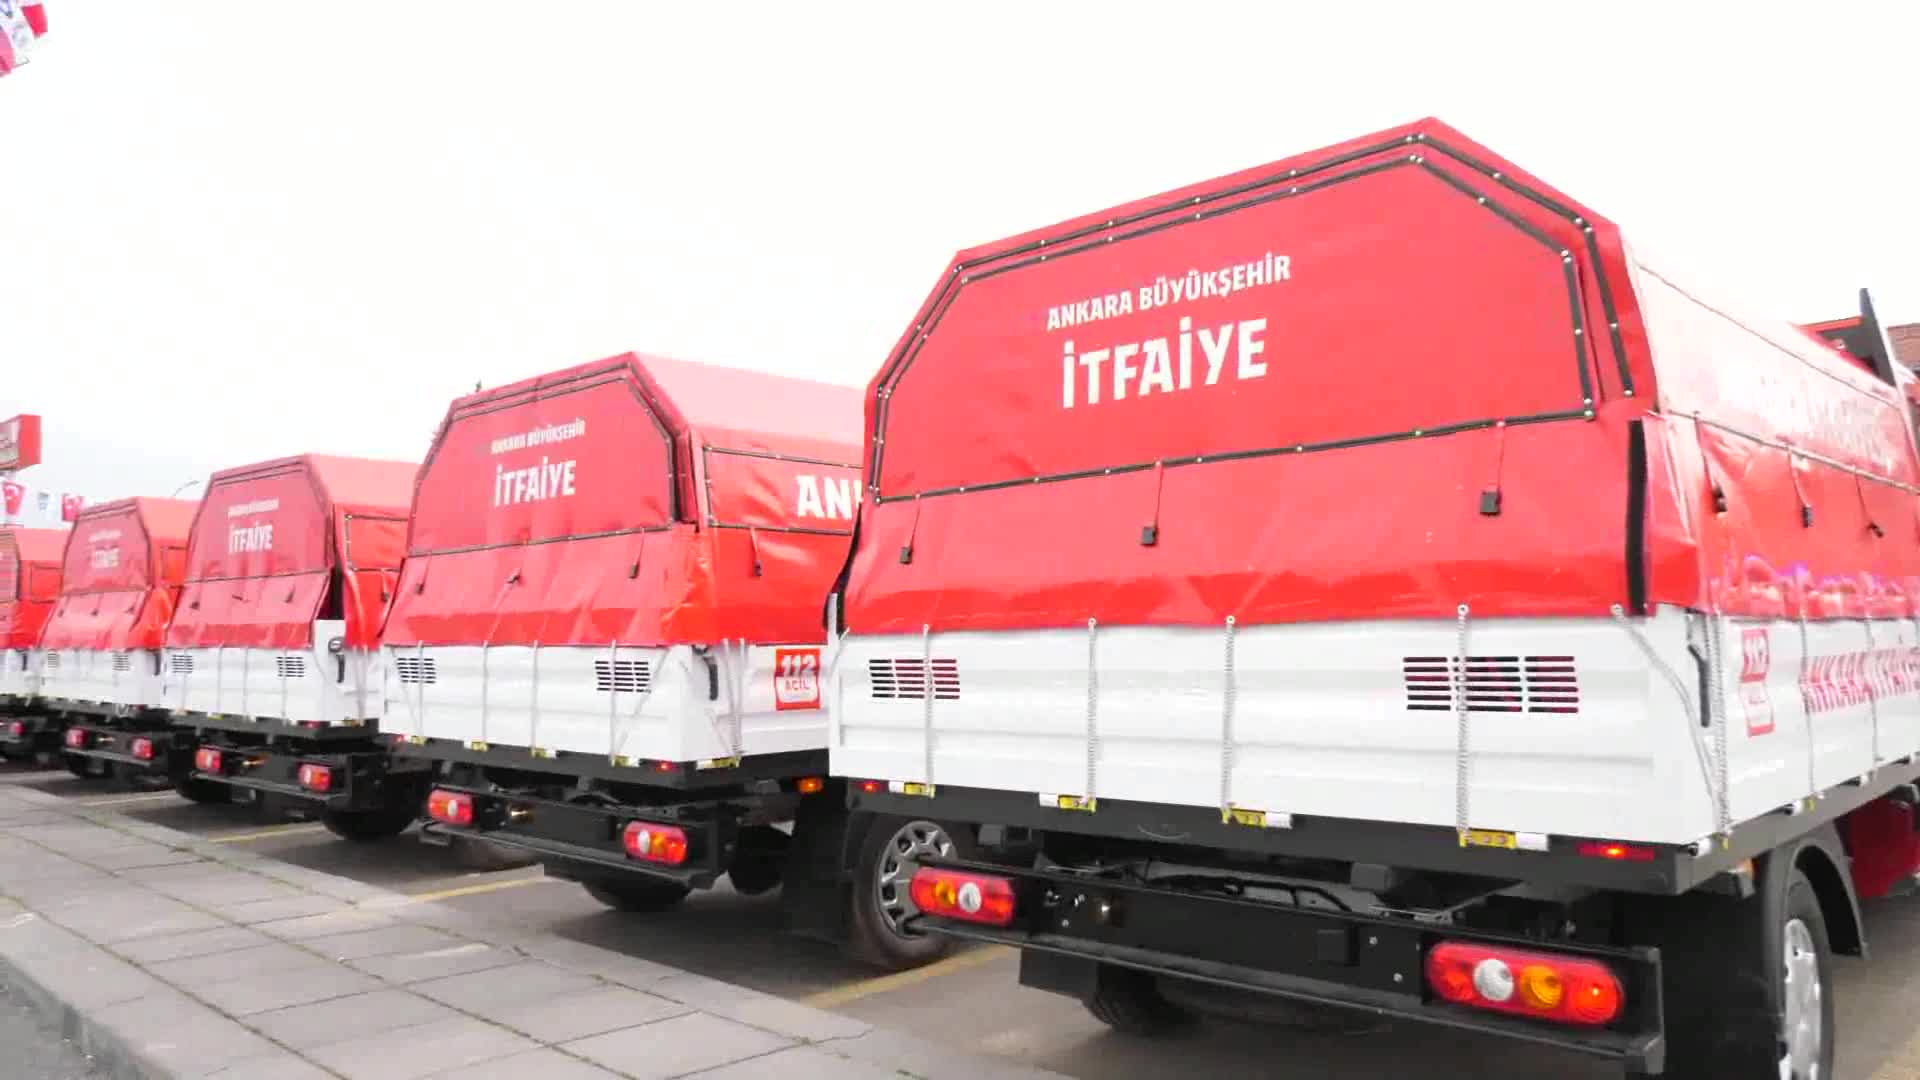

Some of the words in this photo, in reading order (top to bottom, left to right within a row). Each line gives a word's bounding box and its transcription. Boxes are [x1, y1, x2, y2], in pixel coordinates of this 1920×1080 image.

[1047, 291, 1133, 331] ANKARA
[1139, 252, 1291, 311] BÜYÜKŞEHİR
[1062, 316, 1268, 409] İTFAİYE
[494, 456, 577, 507] İTFAİYE
[782, 654, 817, 678] 112
